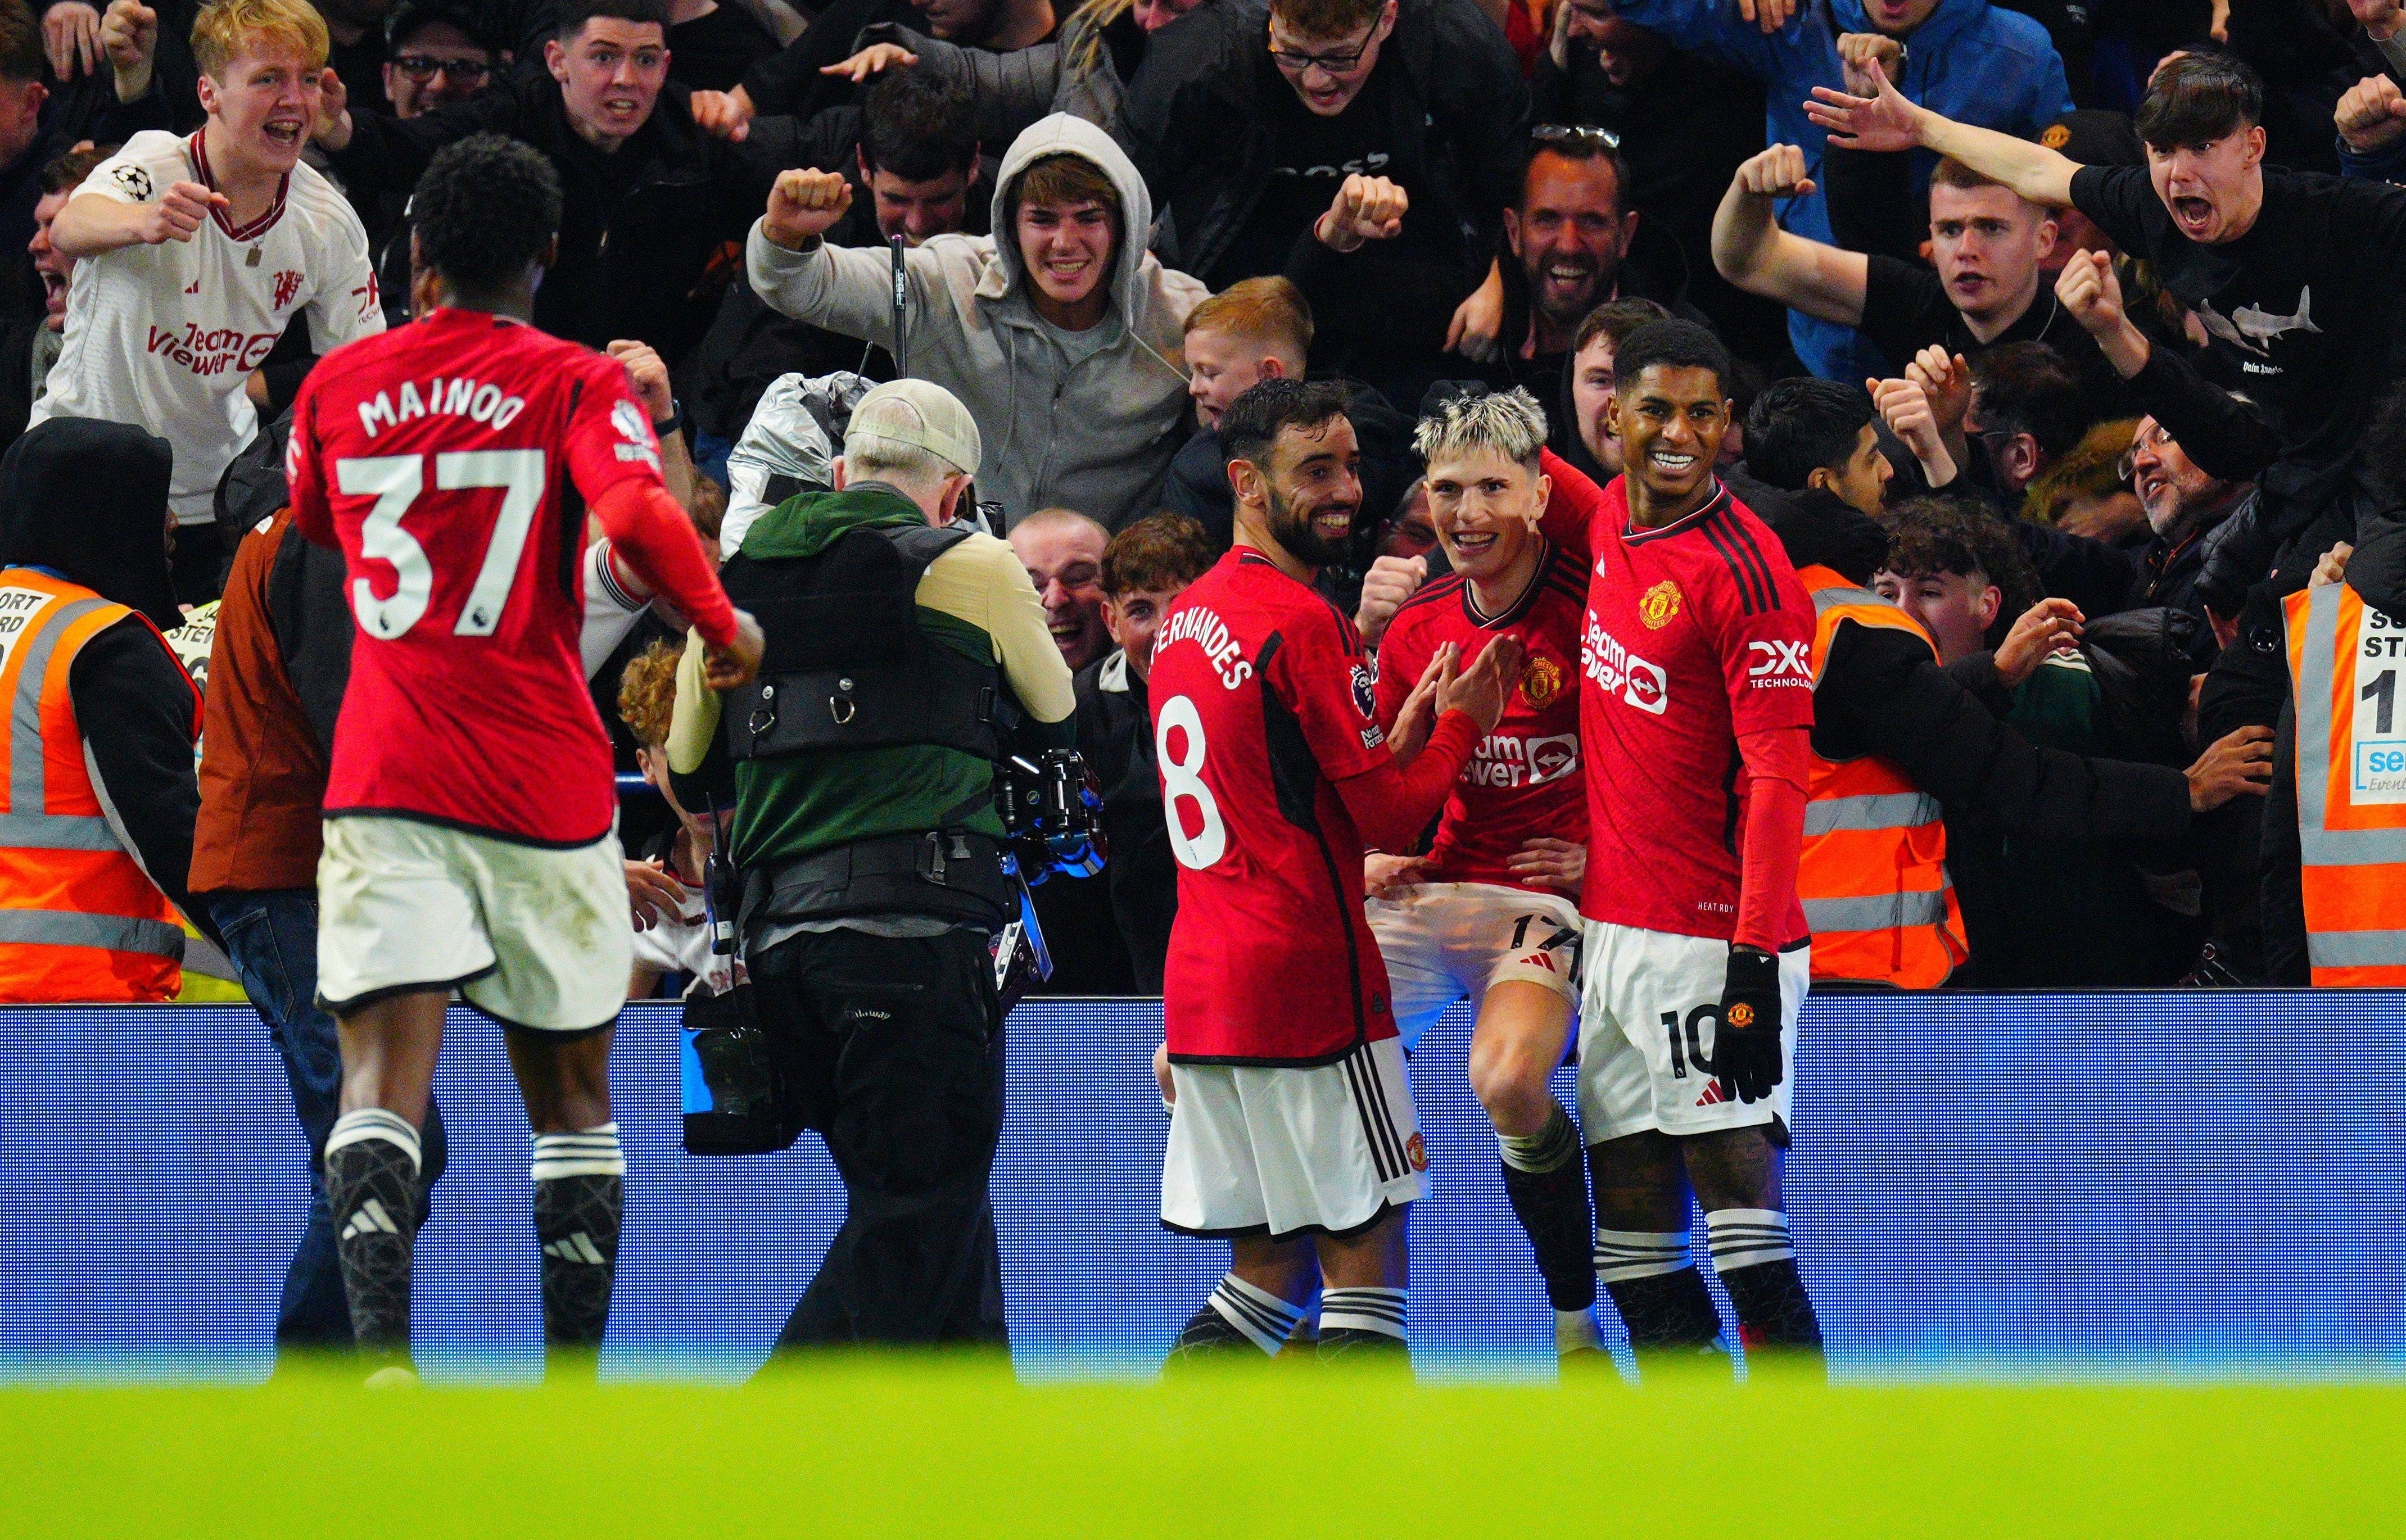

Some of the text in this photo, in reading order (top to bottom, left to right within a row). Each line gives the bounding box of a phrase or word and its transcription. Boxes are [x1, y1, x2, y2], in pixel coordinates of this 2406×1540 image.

[148, 325, 236, 375] Viewer
[183, 322, 243, 352] Team
[358, 378, 525, 438] MAINOO
[336, 450, 545, 640] 37
[1589, 608, 1626, 673] Team
[1643, 615, 1665, 626] UNITED
[2364, 636, 2406, 657] ST
[1156, 695, 1226, 871] 8
[2369, 751, 2406, 772] se
[1698, 902, 1734, 913] HEAT.RDY
[1661, 1004, 1720, 1079] 10
